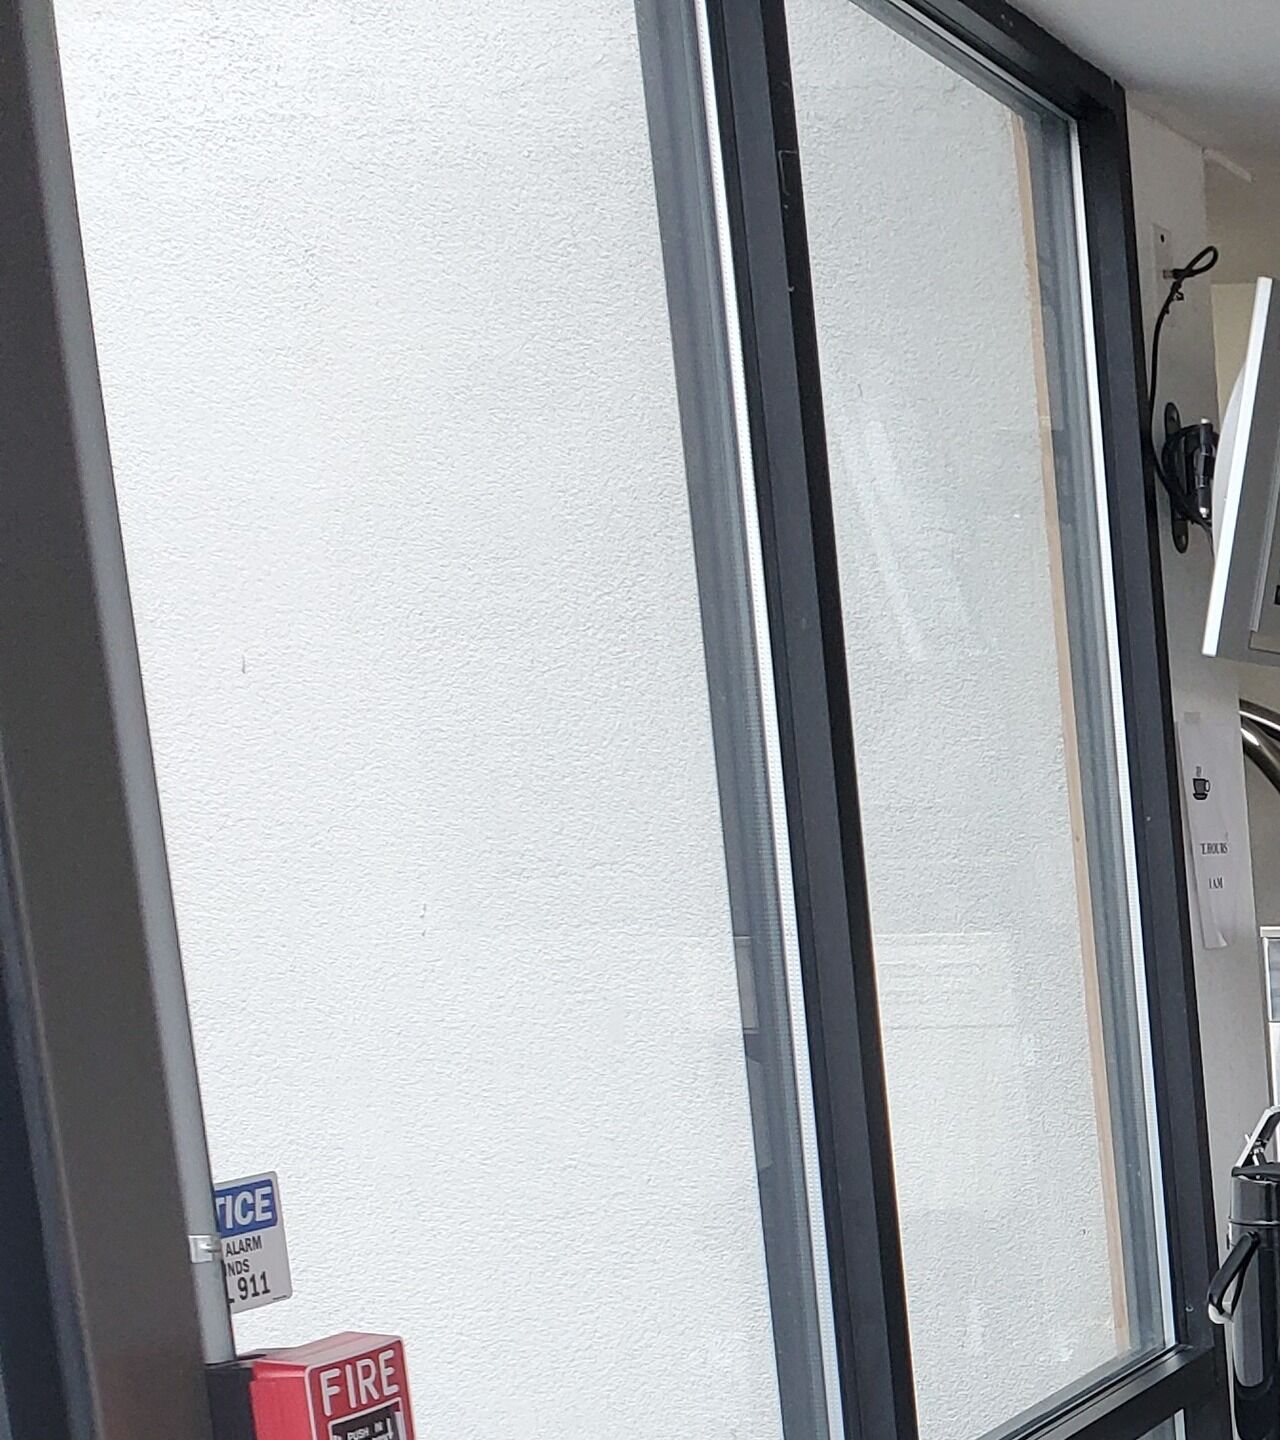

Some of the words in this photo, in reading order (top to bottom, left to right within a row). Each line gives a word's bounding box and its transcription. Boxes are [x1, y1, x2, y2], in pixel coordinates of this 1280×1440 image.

[225, 1235, 263, 1258] ALARM
[237, 1271, 271, 1301] 911
[319, 1349, 401, 1418] FIRE
